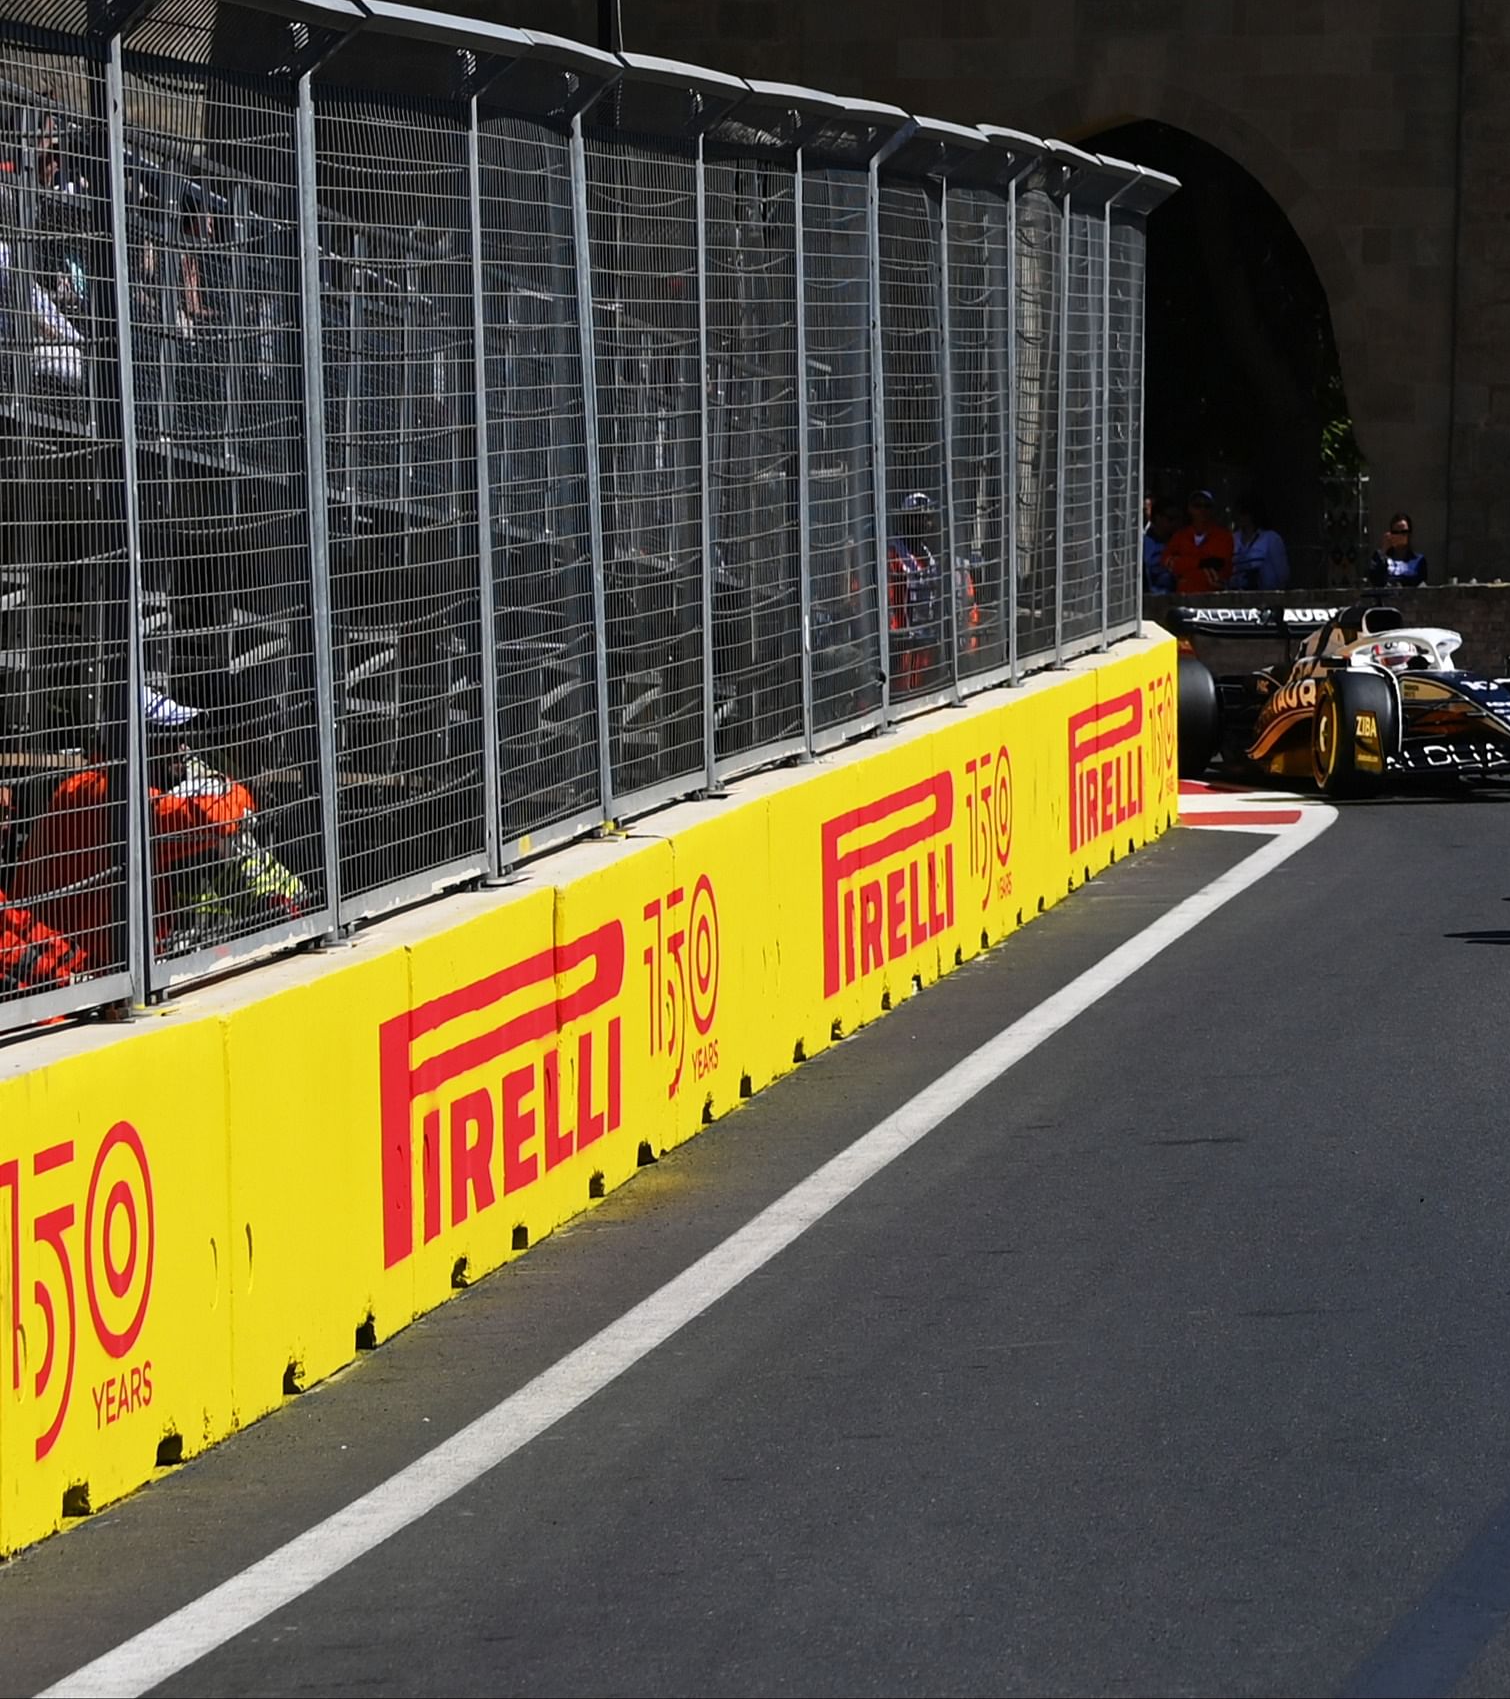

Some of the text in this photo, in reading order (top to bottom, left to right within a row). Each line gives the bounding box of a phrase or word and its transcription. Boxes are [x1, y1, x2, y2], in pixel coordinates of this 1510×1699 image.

[1068, 687, 1143, 855] PIRELLI
[1355, 715, 1378, 738] ZIBA
[821, 770, 954, 1000] PIRELLI
[966, 744, 1013, 912] 150
[643, 873, 720, 1101] 150
[691, 1038, 720, 1084] YEARS
[379, 918, 625, 1271] PIRELLI
[92, 1360, 154, 1431] YEARS
